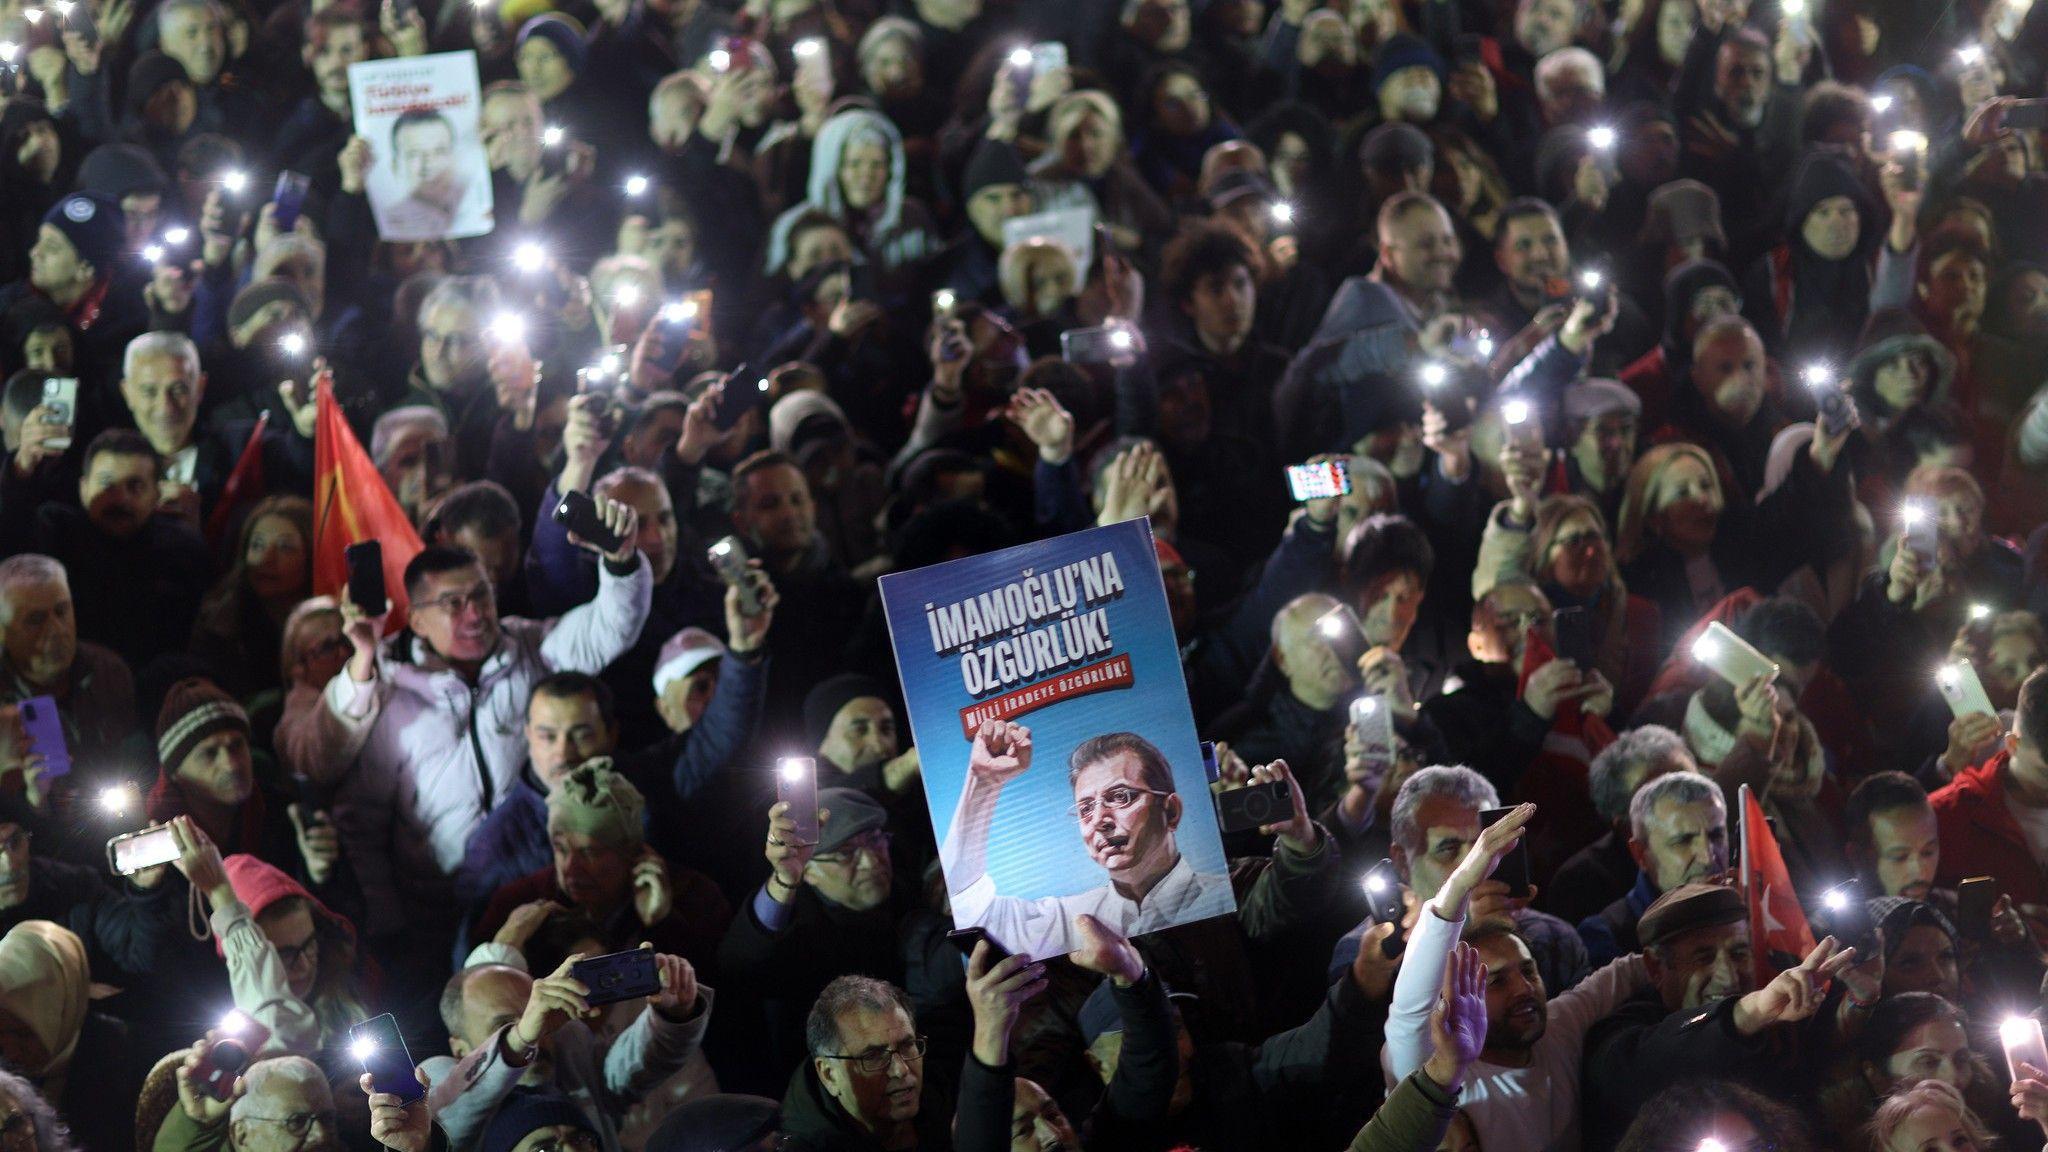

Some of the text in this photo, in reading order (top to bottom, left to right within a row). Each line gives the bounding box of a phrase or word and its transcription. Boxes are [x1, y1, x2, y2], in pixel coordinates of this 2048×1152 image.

[926, 552, 1124, 653] İMAMOĞLU'NA
[960, 608, 1113, 696] ÖZGÜRLÜK!
[966, 660, 1129, 730] MİLLİ İRADEYE ÖZGÜRLÜK!
